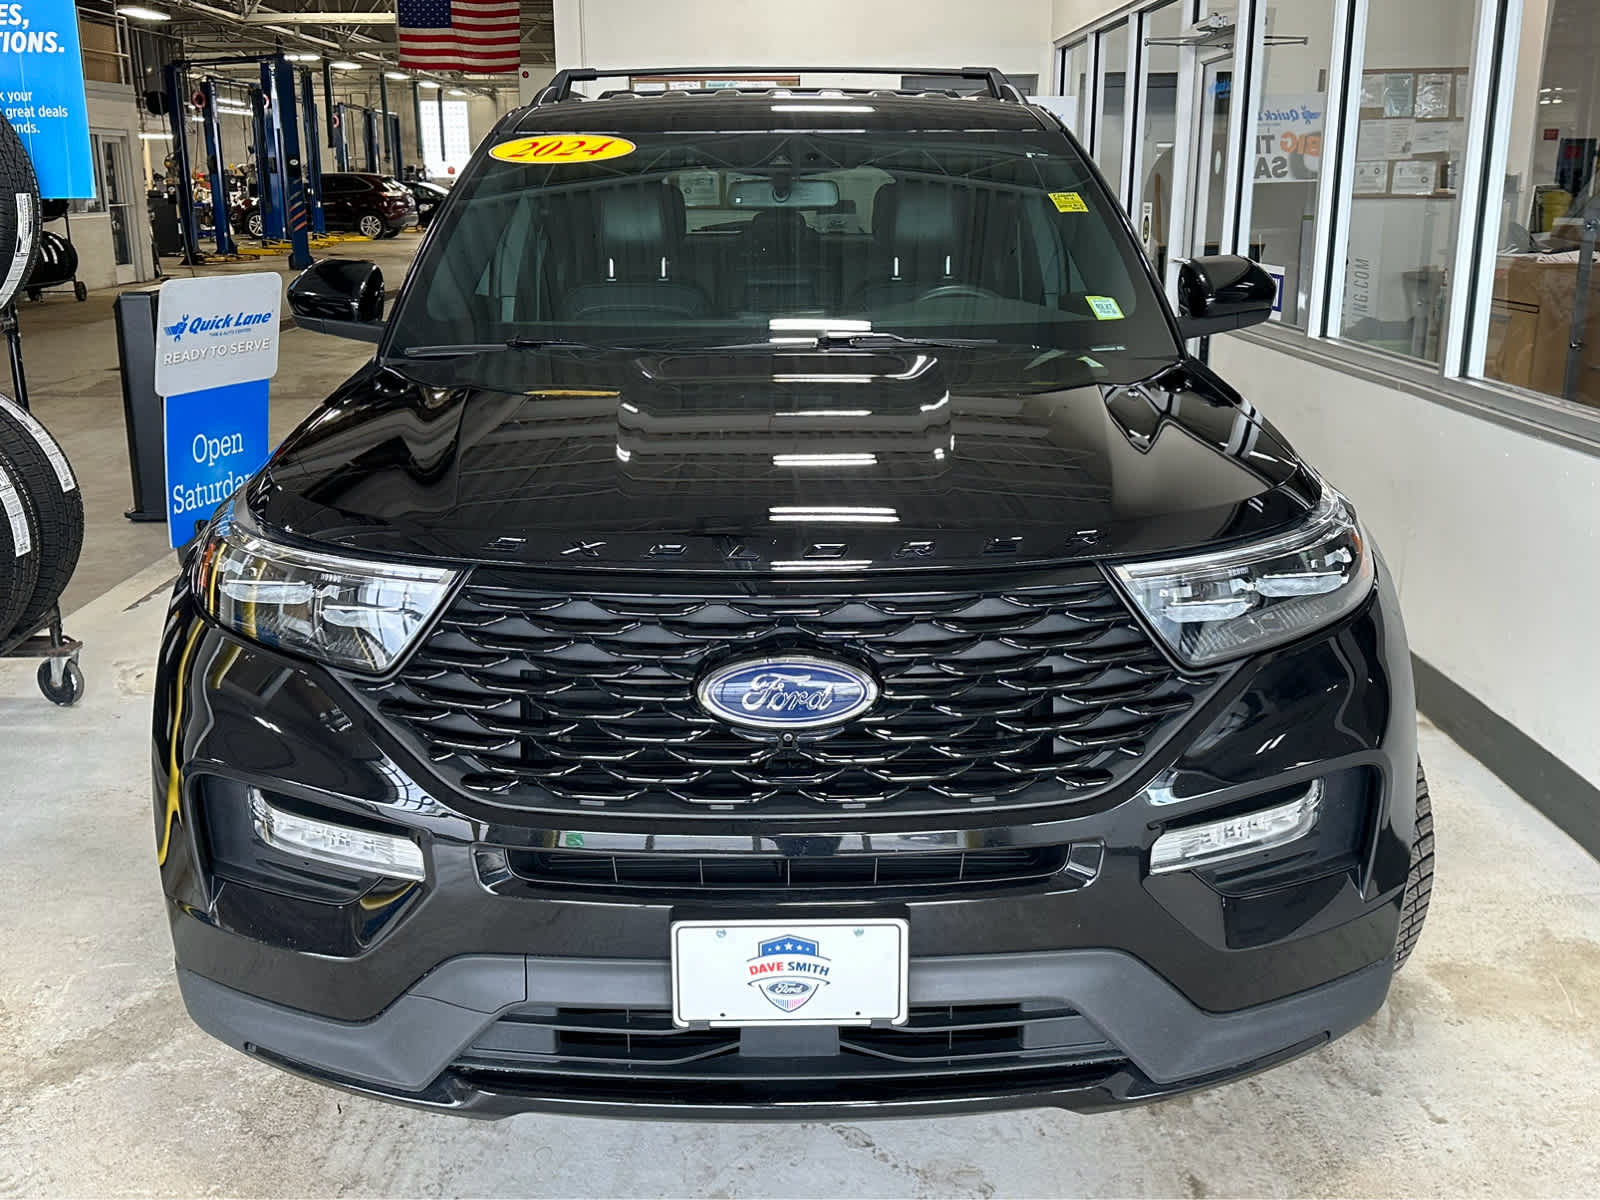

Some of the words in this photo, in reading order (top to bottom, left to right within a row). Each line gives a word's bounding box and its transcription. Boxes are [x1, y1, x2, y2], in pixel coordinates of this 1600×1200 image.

[7, 91, 33, 104] your
[5, 105, 36, 120] great
[38, 105, 69, 118] deals
[506, 140, 616, 158] 2024
[188, 313, 234, 335] Quick
[234, 311, 272, 327] Lane
[163, 346, 208, 366] READY
[211, 344, 228, 357] TO
[230, 337, 271, 354] SERVE
[192, 432, 244, 467] Open
[741, 672, 834, 711] Ford
[749, 961, 784, 976] DAVE
[787, 961, 830, 976] SMITH
